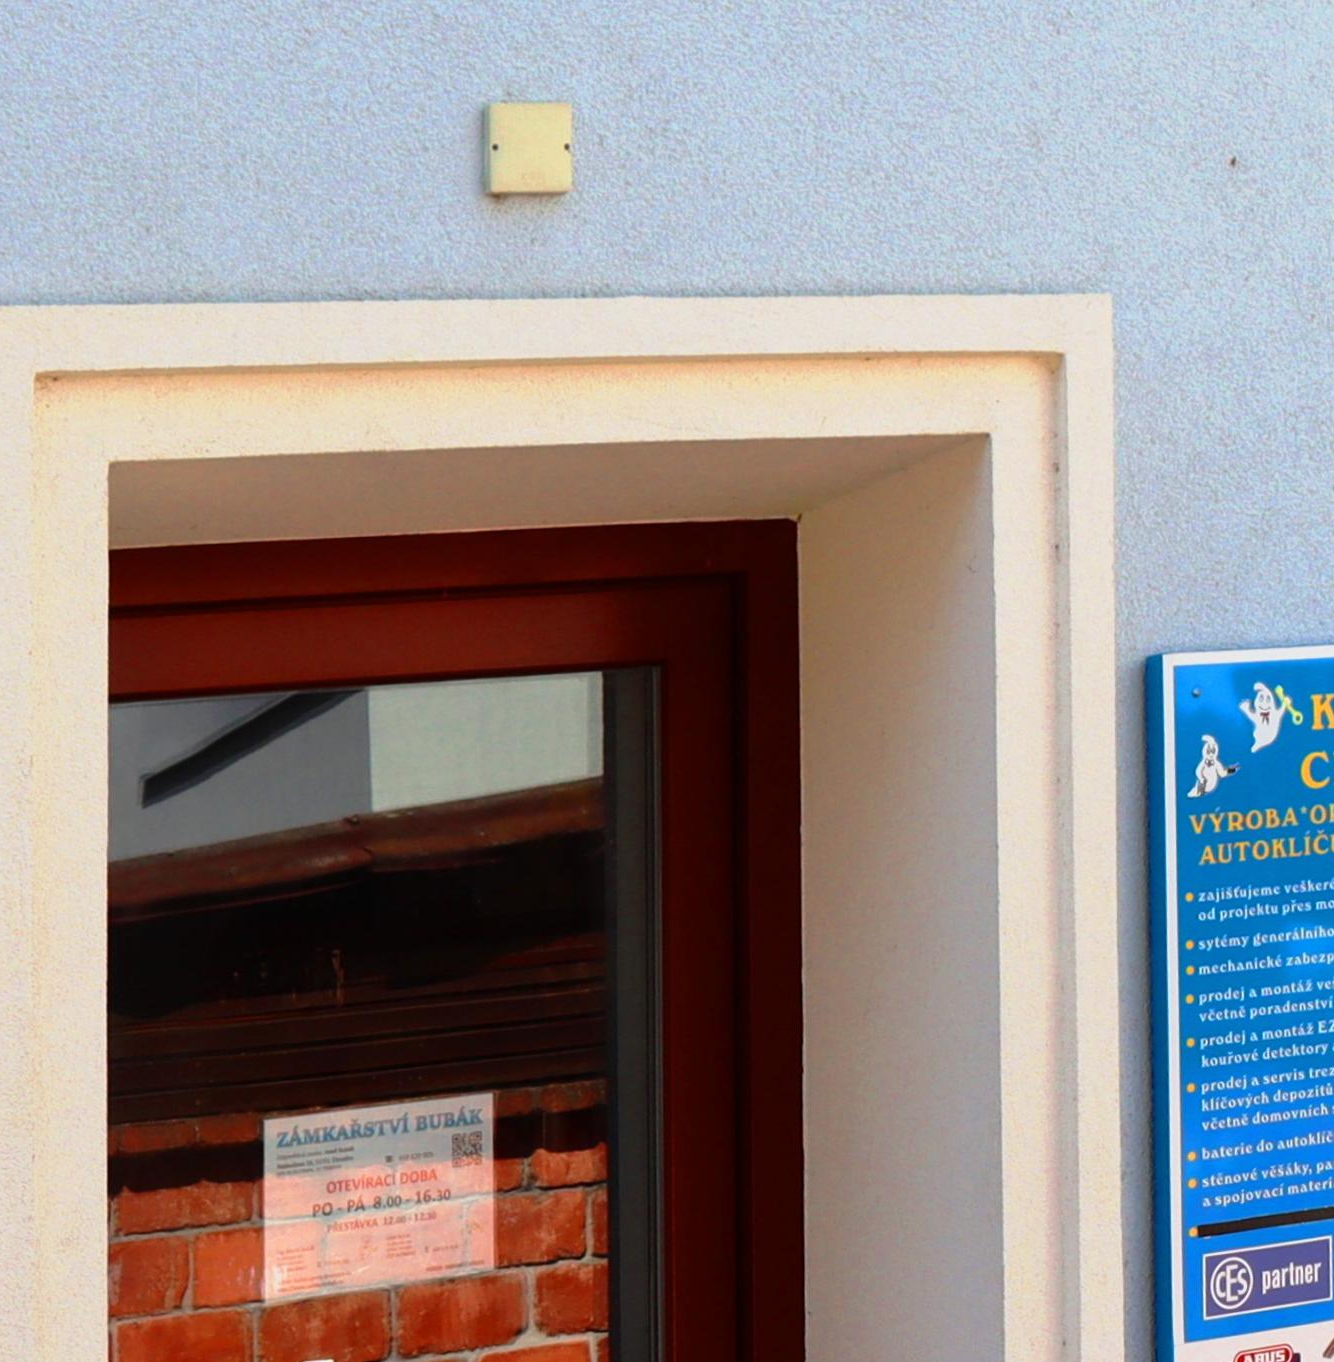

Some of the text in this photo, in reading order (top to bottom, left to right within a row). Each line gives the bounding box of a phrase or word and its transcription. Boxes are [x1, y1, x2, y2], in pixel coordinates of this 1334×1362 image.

[1198, 885, 1280, 902] zajišťujeme
[1199, 908, 1215, 921] od
[1220, 903, 1278, 921] projektu
[1282, 901, 1311, 915] přes
[1198, 935, 1249, 951] sytémy
[1253, 924, 1334, 946] generálního
[1199, 955, 1282, 975] mechanické
[1199, 987, 1245, 1005] prodej
[1249, 989, 1257, 998] a
[1261, 980, 1313, 996] montáž
[1199, 996, 1333, 1022] včetně poradenství
[1200, 1032, 1245, 1049] prodej
[1250, 1032, 1258, 1041] a
[1262, 1023, 1314, 1040] montáž
[1201, 1050, 1258, 1068] kouřové
[1263, 1043, 1328, 1060] detektory
[1201, 1076, 1247, 1094] prodej
[1251, 1077, 1259, 1086] a
[1263, 1068, 1305, 1084] servis
[1201, 1093, 1269, 1112] klíčových
[1273, 1083, 1333, 1102] depozitů
[277, 1106, 483, 1148] ZÁMKAŘSTVÍ BUBÁK
[1202, 1114, 1249, 1131] včetně
[1252, 1104, 1328, 1124] domovních
[1202, 1143, 1253, 1160] baterie
[1256, 1140, 1273, 1152] do
[327, 1169, 437, 1194] OTEVÍRACÍ DOBA
[1202, 1168, 1262, 1188] stěnové
[1262, 1161, 1312, 1178] věšáky,
[313, 1203, 332, 1217] PO
[347, 1196, 365, 1212] PÁ
[374, 1195, 402, 1209] 8.00
[417, 1189, 450, 1204] 16.30
[1203, 1198, 1211, 1207] a
[1215, 1185, 1283, 1207] spojovací
[1262, 1262, 1321, 1294] partner
